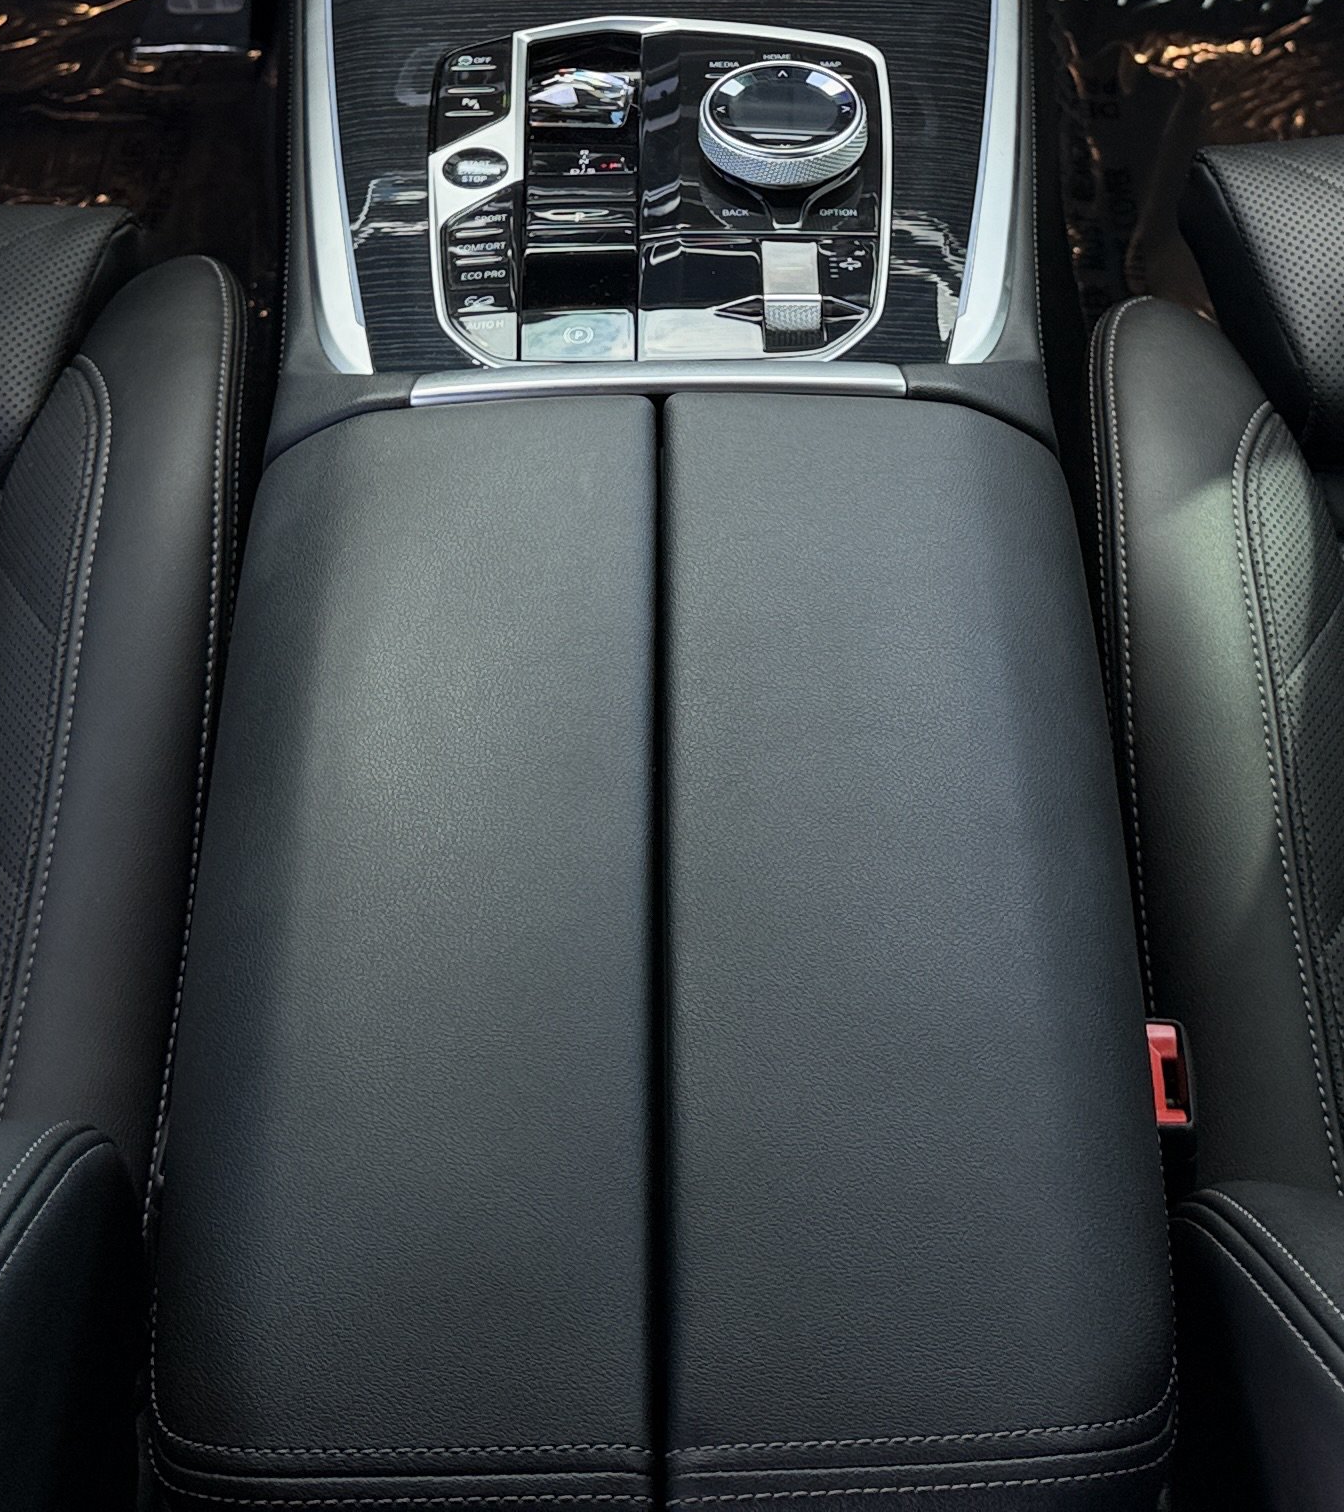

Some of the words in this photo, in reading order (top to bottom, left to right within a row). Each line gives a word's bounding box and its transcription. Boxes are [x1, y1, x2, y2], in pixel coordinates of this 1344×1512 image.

[473, 56, 492, 64] OFF
[819, 60, 841, 68] MAP
[461, 175, 488, 183] STOP
[722, 208, 749, 217] BACK
[819, 208, 857, 217] OPTION
[474, 213, 508, 222] SPORT
[456, 241, 507, 252] COMFORT
[460, 271, 482, 281] ECO
[484, 269, 506, 279] PRO
